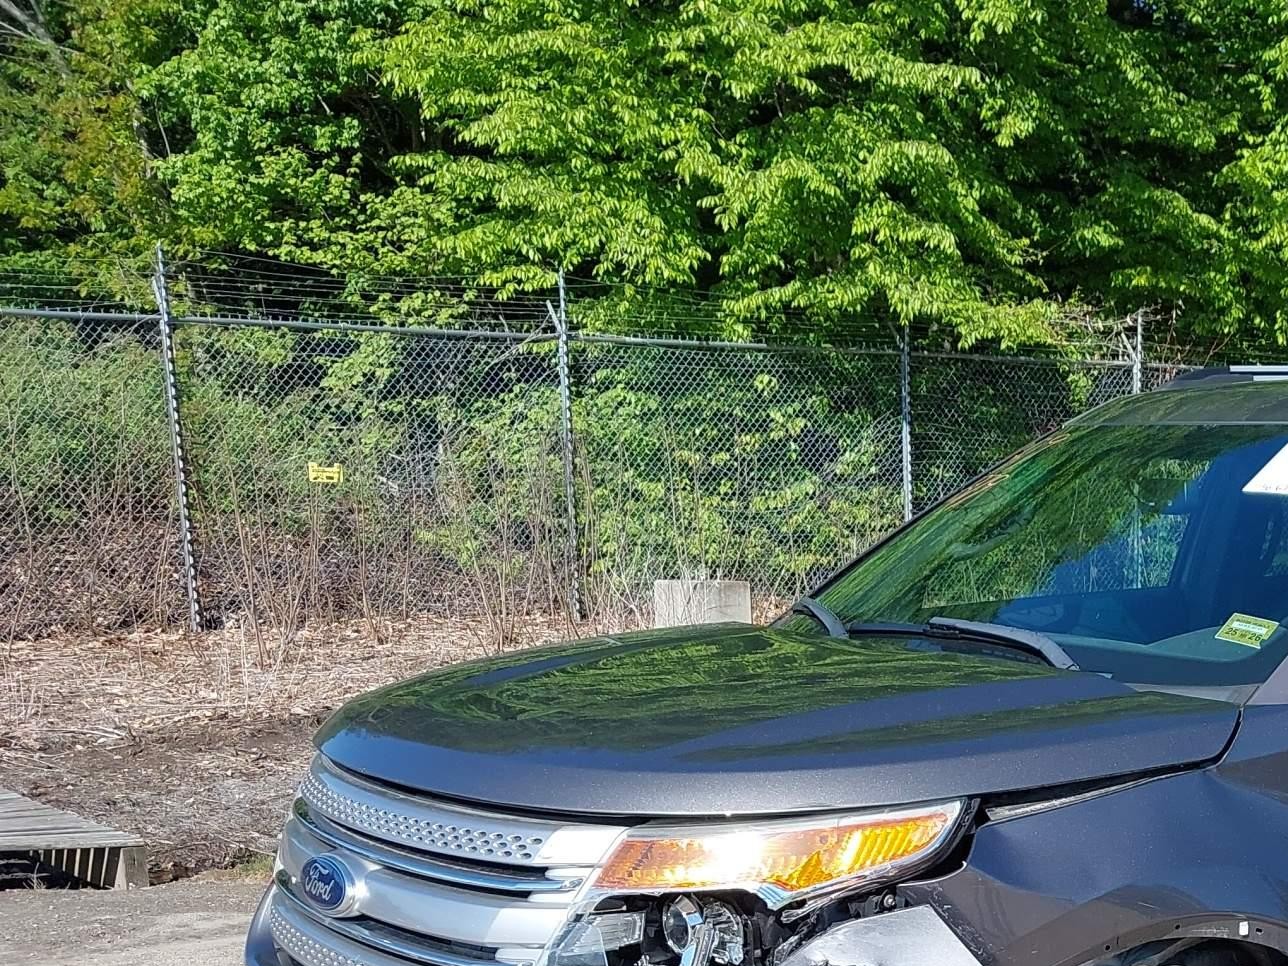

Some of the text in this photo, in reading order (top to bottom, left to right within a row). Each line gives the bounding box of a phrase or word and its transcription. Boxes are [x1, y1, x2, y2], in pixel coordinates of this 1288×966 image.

[1224, 627, 1238, 636] 25
[1248, 632, 1263, 642] 26
[305, 863, 335, 901] Ford
